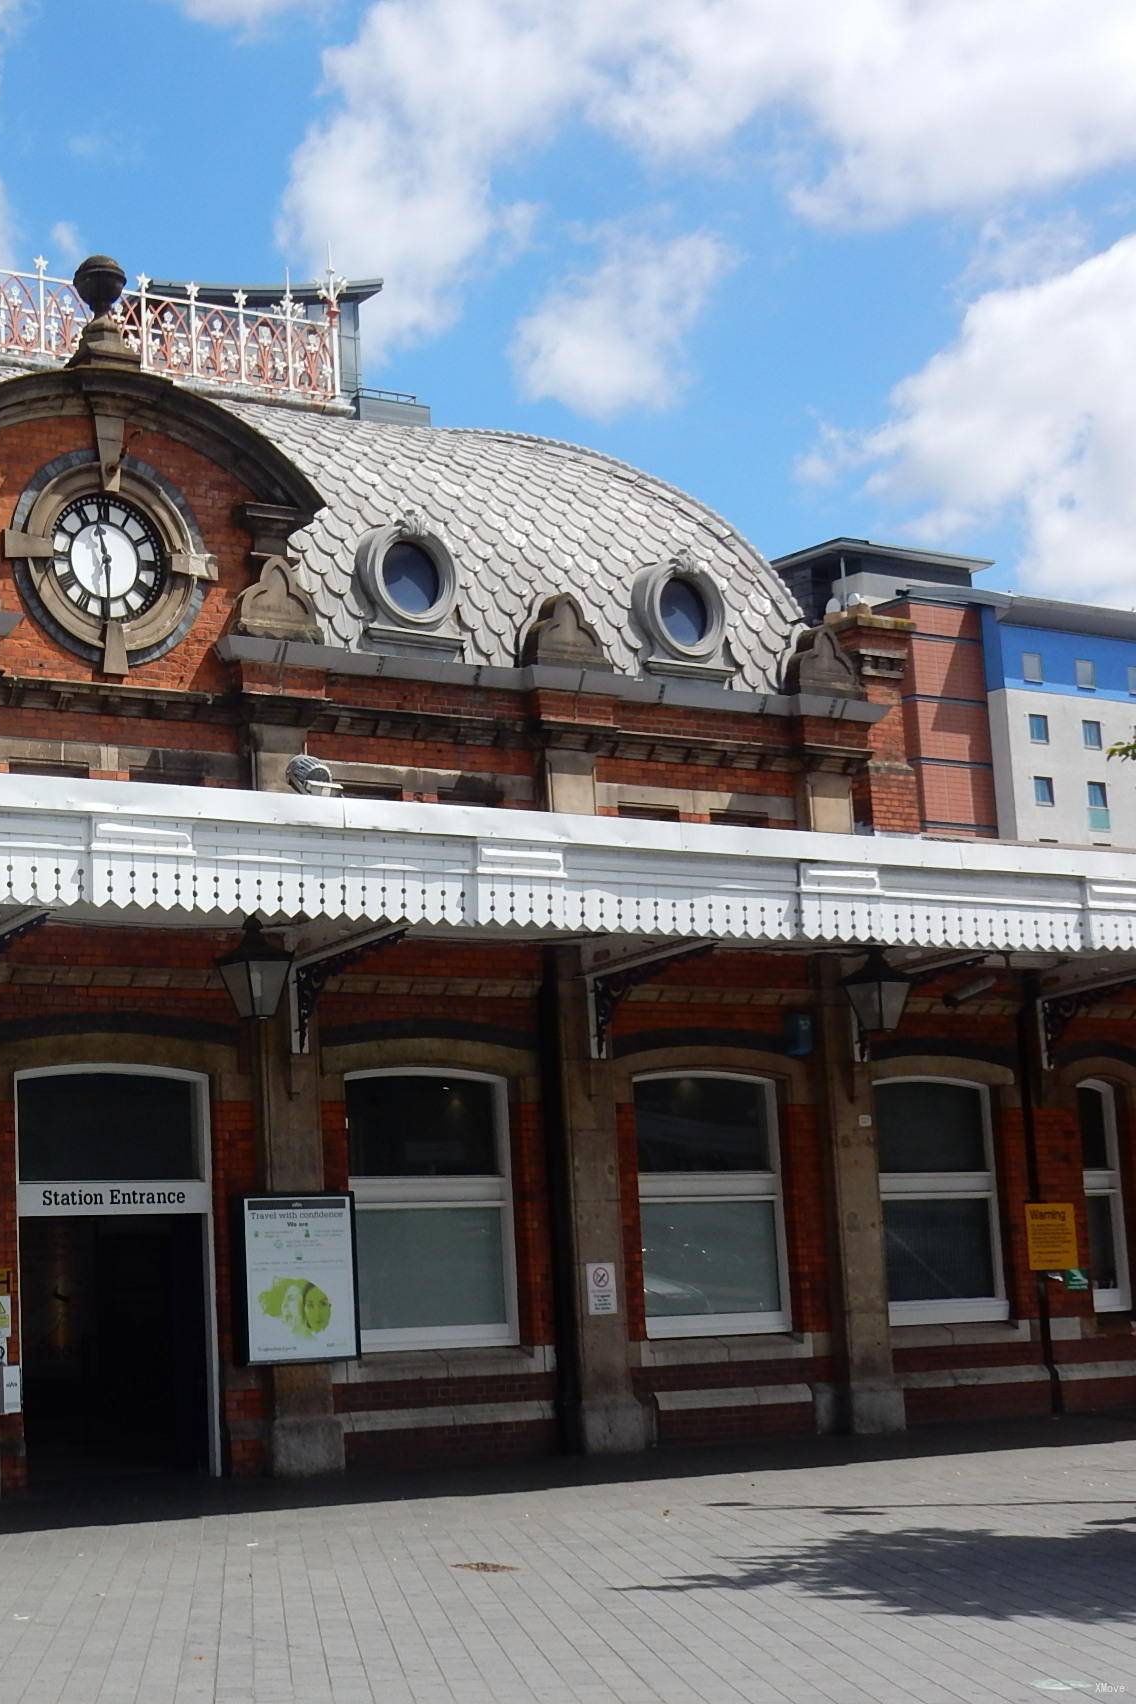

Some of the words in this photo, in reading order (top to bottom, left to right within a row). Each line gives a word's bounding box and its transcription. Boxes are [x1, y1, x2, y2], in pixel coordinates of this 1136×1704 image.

[42, 1190, 104, 1206] Station
[109, 1189, 185, 1205] Entrance
[250, 1212, 277, 1220] Travel
[279, 1211, 298, 1219] with
[299, 1210, 344, 1219] confidence
[1029, 1209, 1066, 1221] Warning
